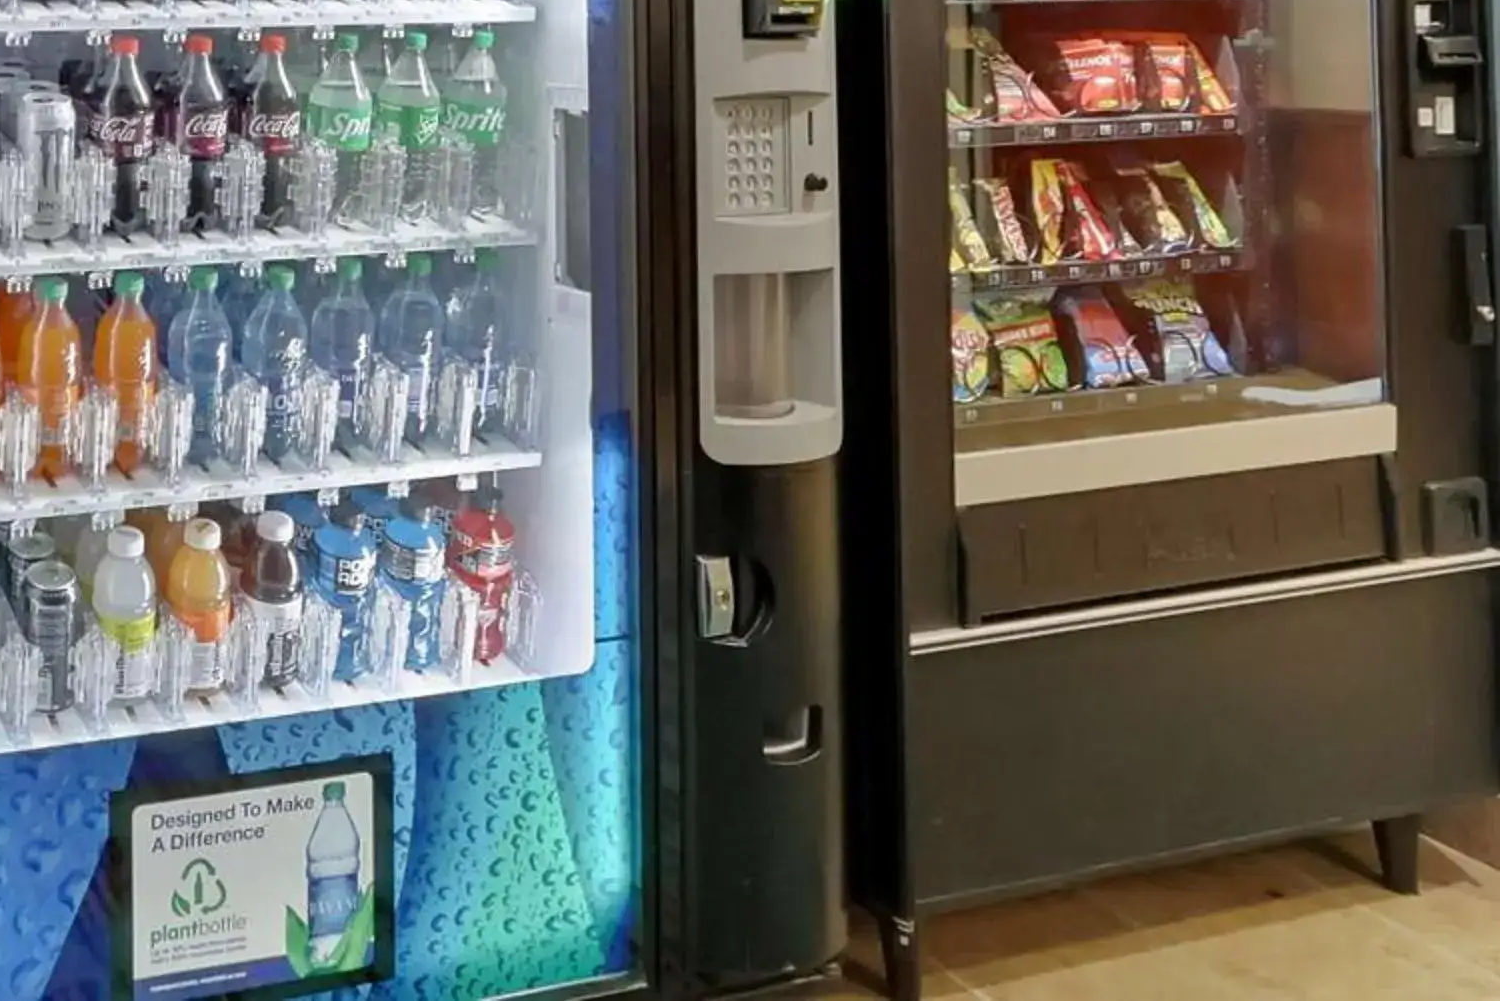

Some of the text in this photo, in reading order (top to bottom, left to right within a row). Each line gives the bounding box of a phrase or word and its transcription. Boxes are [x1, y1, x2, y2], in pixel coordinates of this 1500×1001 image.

[151, 795, 315, 830] Designed To Make
[151, 825, 266, 853] A Difference
